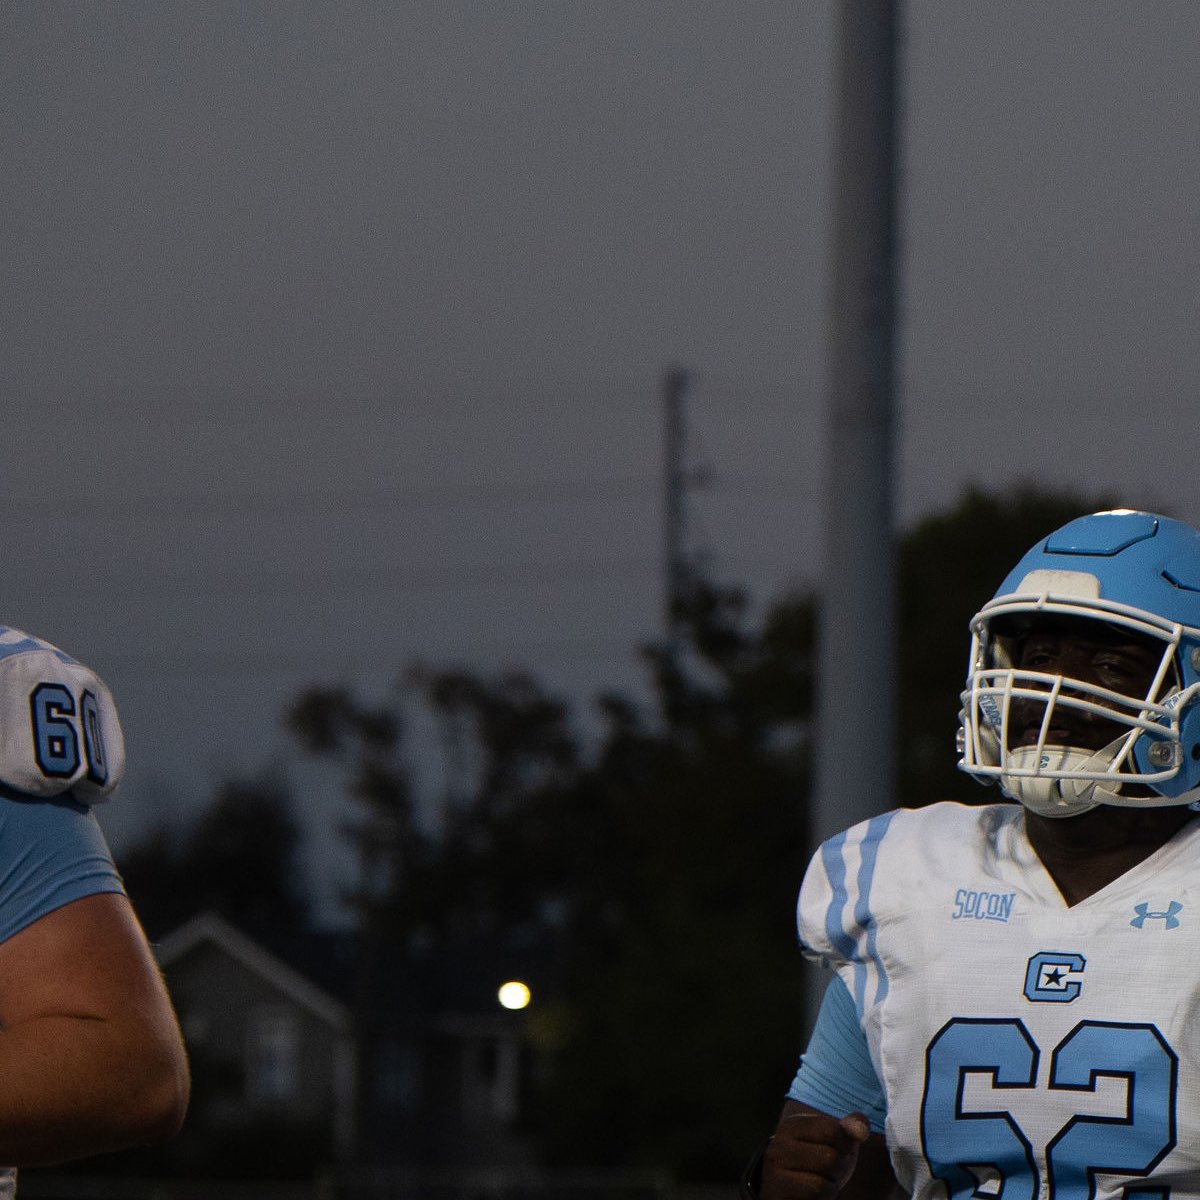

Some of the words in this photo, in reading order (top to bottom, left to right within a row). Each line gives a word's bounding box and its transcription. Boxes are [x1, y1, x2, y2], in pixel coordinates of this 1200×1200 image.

[31, 682, 109, 787] 60
[952, 888, 1017, 922] SOCON
[1023, 951, 1087, 1003] C
